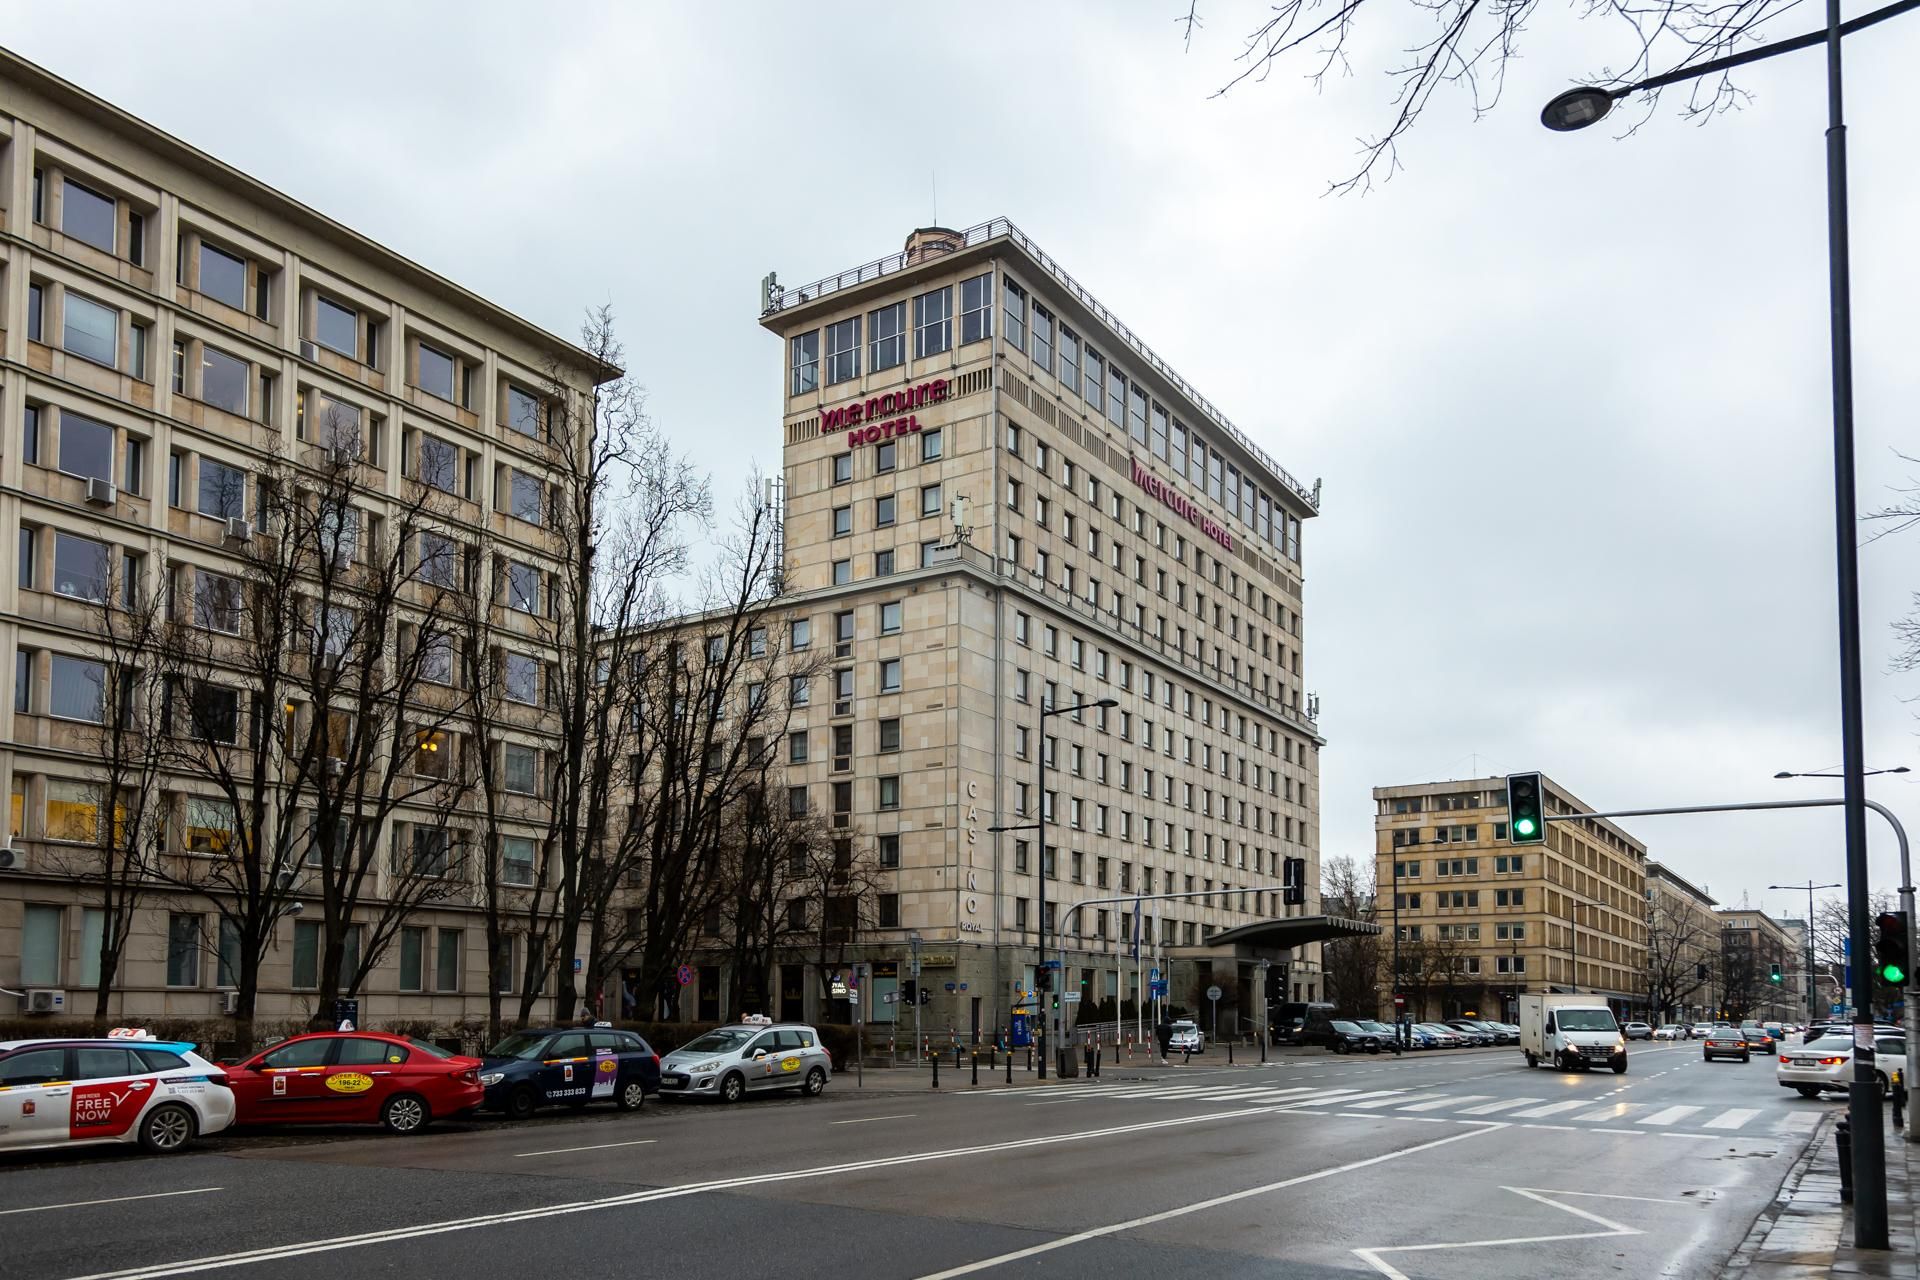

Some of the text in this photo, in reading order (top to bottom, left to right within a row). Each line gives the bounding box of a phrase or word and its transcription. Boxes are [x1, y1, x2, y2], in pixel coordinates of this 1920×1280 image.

[848, 415, 922, 448] HOTEL
[1202, 515, 1233, 552] HOTEL
[967, 781, 977, 914] CASINO
[961, 922, 982, 933] ROYAL
[75, 1109, 111, 1122] NOW
[76, 1098, 111, 1111] FREE
